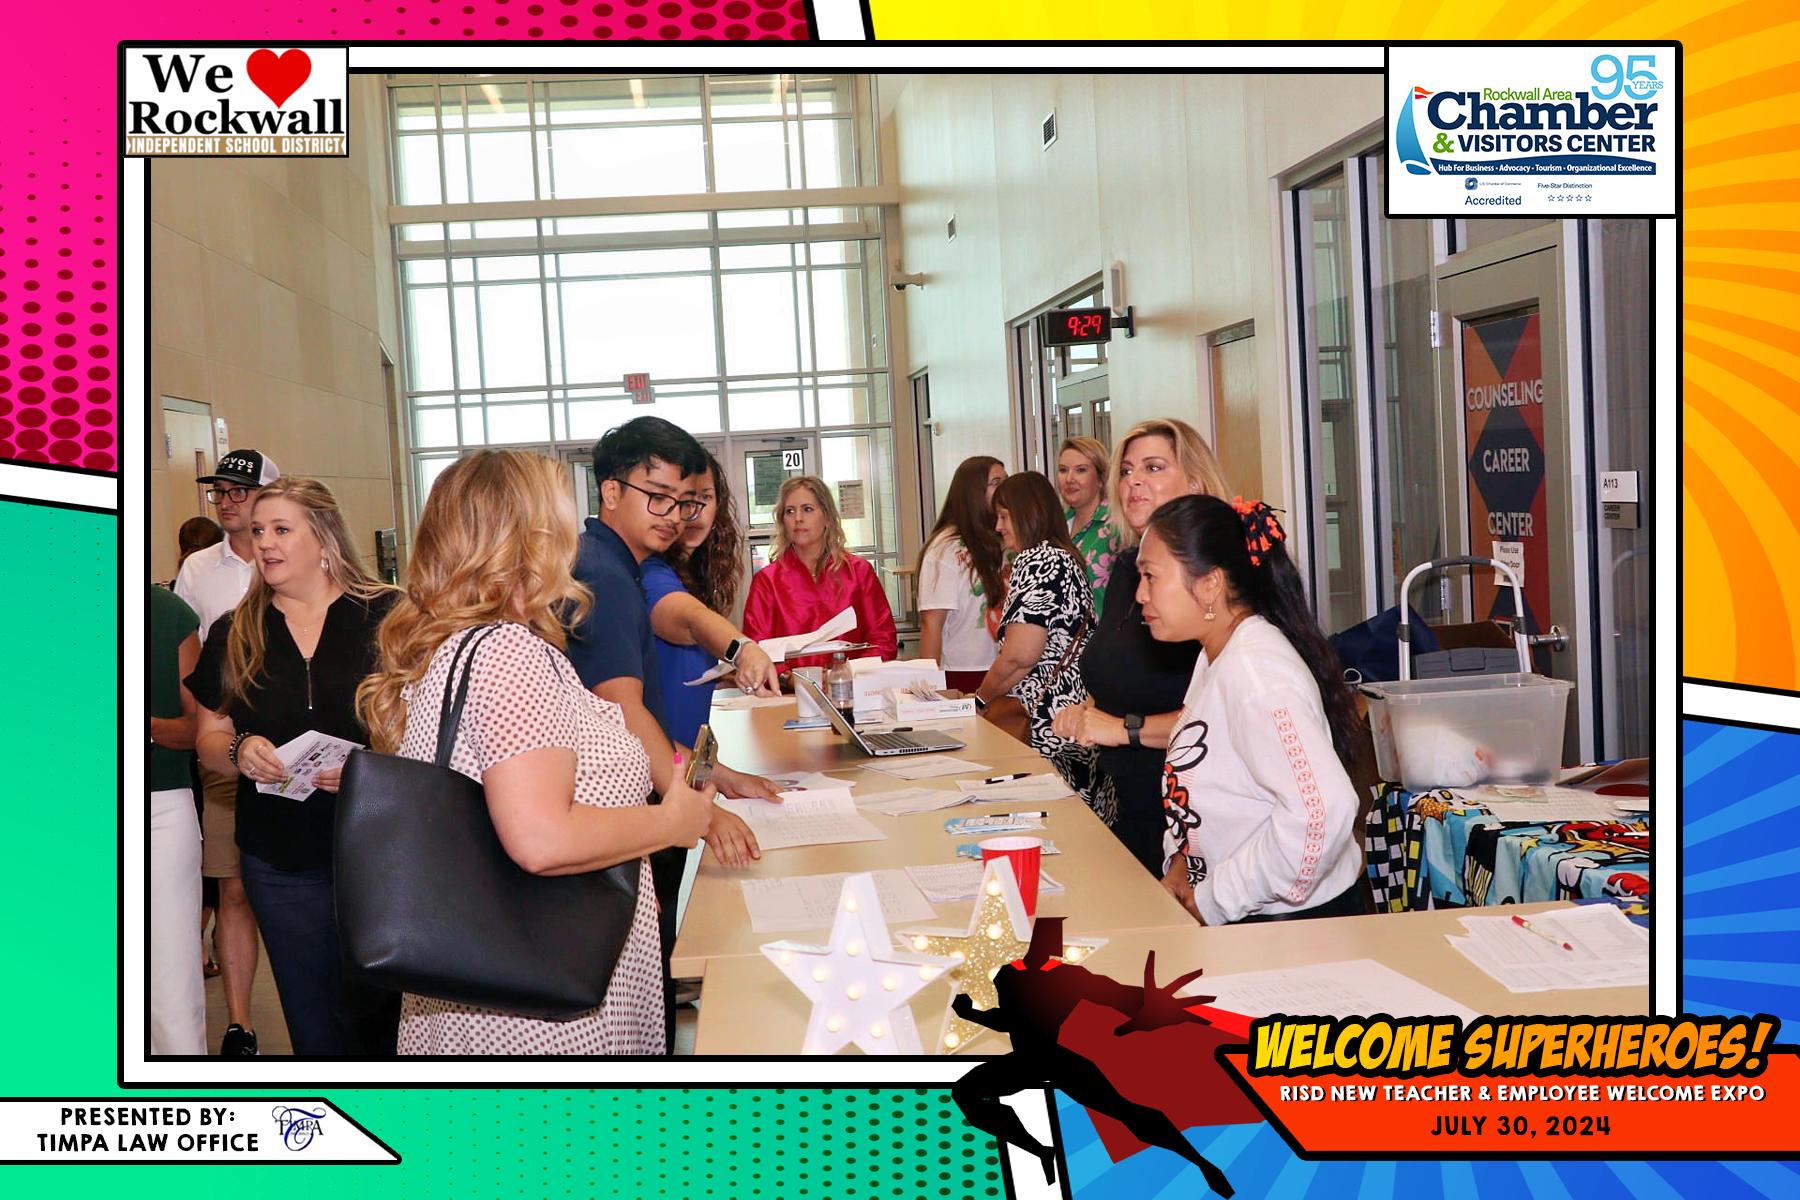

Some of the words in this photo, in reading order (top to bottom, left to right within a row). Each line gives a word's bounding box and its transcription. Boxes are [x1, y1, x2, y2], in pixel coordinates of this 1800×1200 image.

[1068, 316, 1102, 336] 9:29
[1467, 379, 1544, 410] COUNSELING
[223, 457, 254, 469] OVOS
[785, 452, 800, 467] 20
[1483, 447, 1530, 473] CAREER
[1603, 478, 1618, 488] A113
[1488, 511, 1534, 537] CENTER
